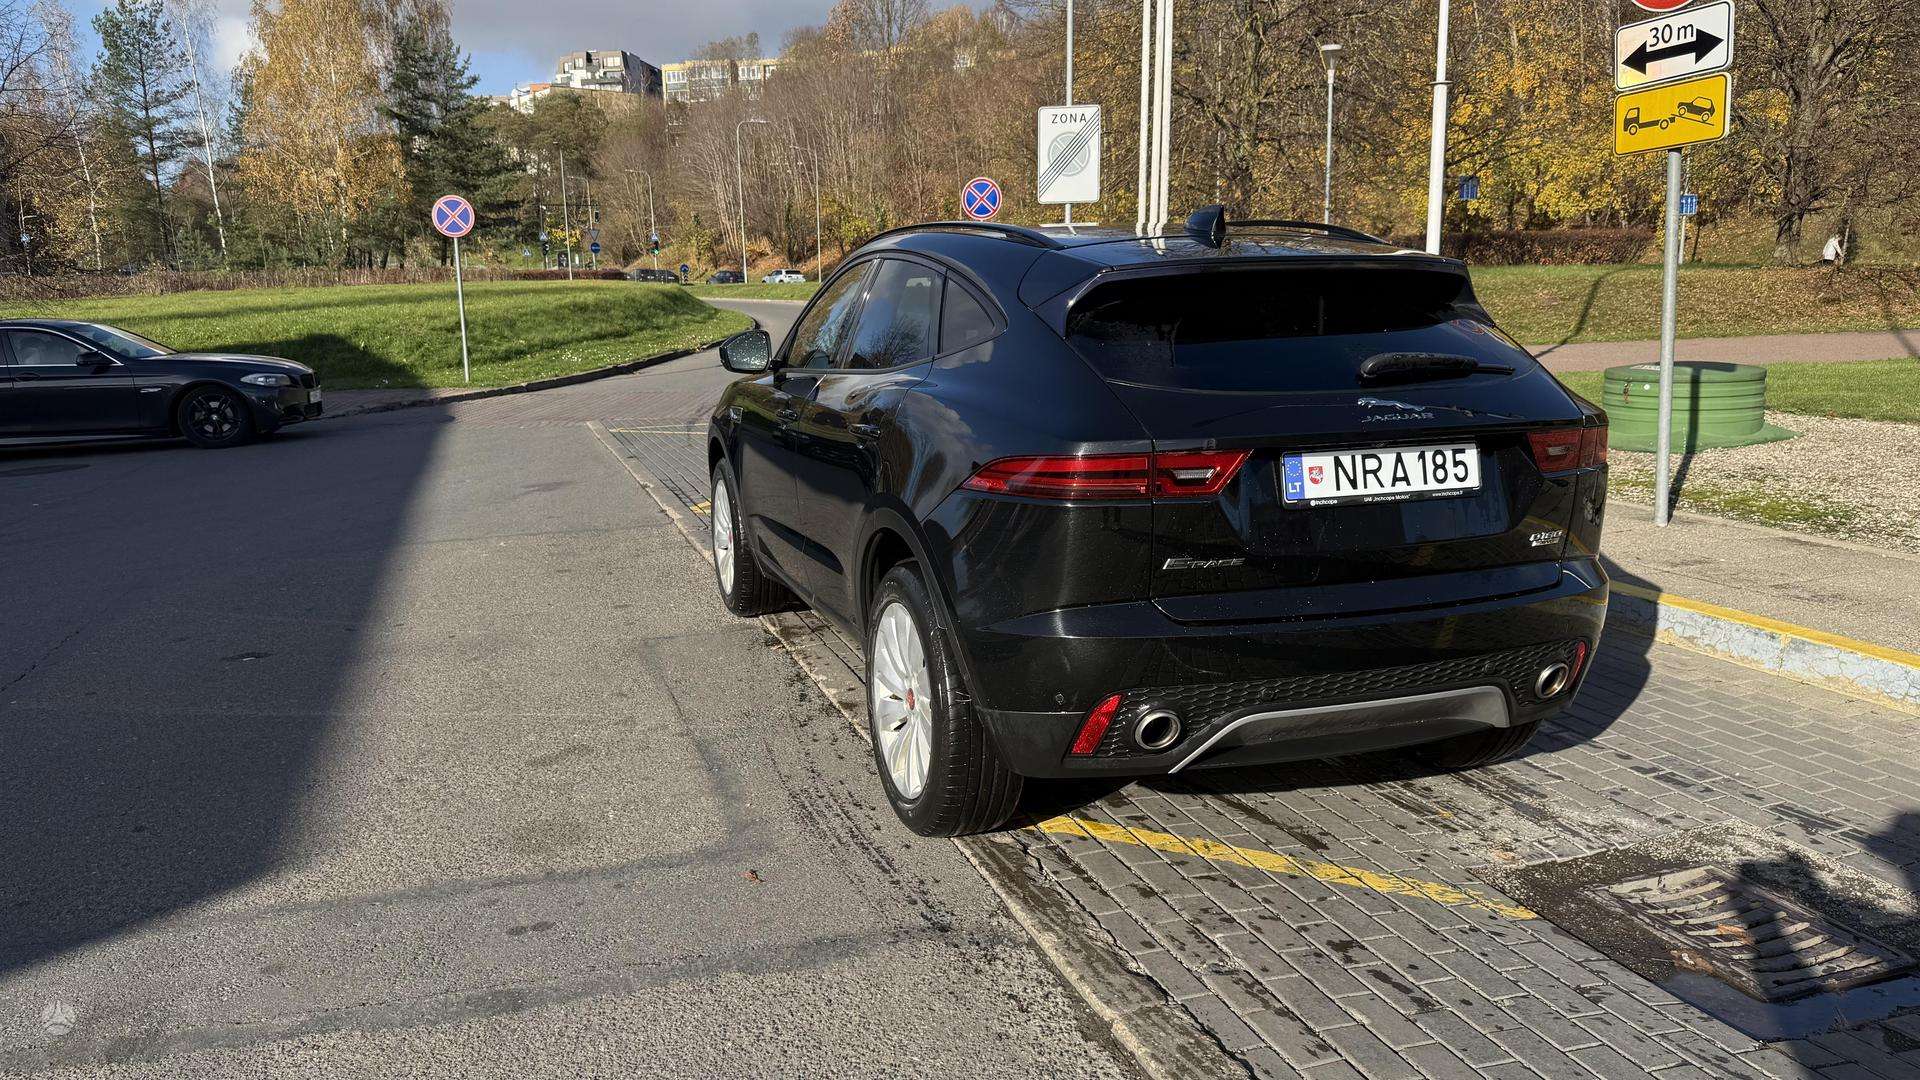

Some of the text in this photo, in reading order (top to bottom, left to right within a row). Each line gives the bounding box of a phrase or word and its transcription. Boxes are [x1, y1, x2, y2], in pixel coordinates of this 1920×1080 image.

[1649, 23, 1694, 48] 30 m
[1051, 113, 1087, 124] ZONA
[1288, 482, 1302, 493] LT
